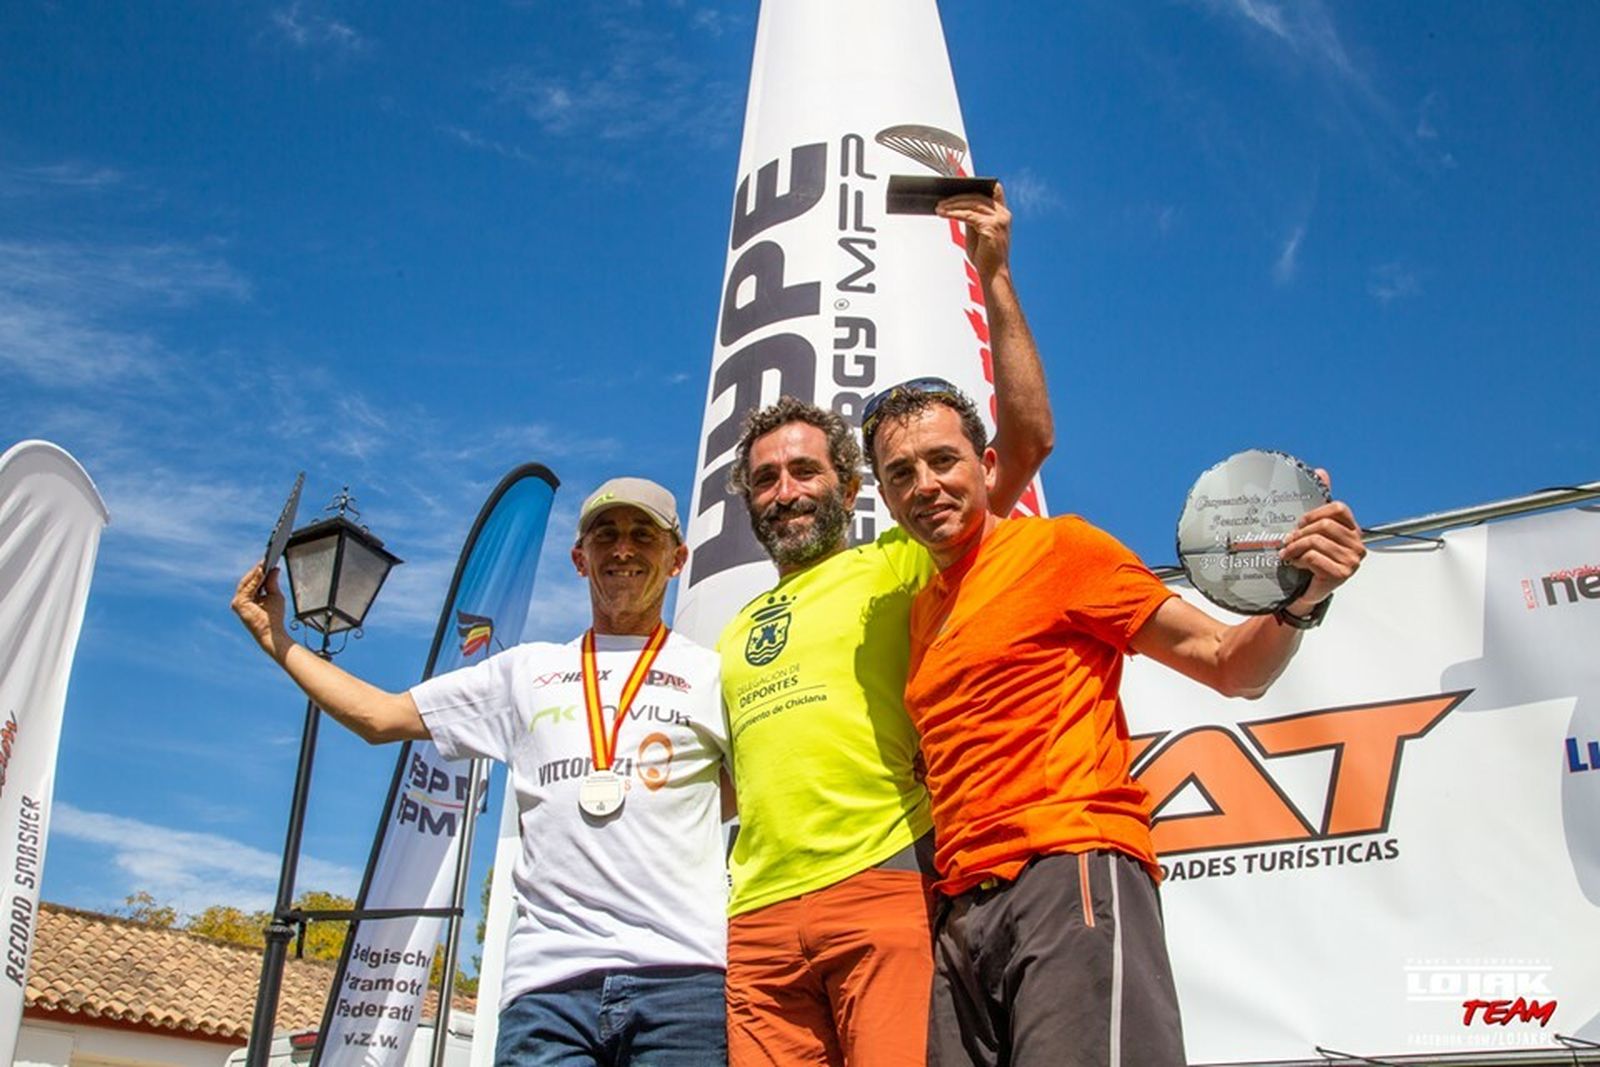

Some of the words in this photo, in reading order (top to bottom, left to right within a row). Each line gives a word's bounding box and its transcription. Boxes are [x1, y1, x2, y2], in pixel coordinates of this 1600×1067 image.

[739, 674, 800, 709] DEPORTES
[14, 795, 41, 890] SMASHER
[1243, 839, 1400, 874] TURÍSTICAS
[5, 895, 33, 987] RECORD
[344, 1032, 399, 1049] v.z.w.
